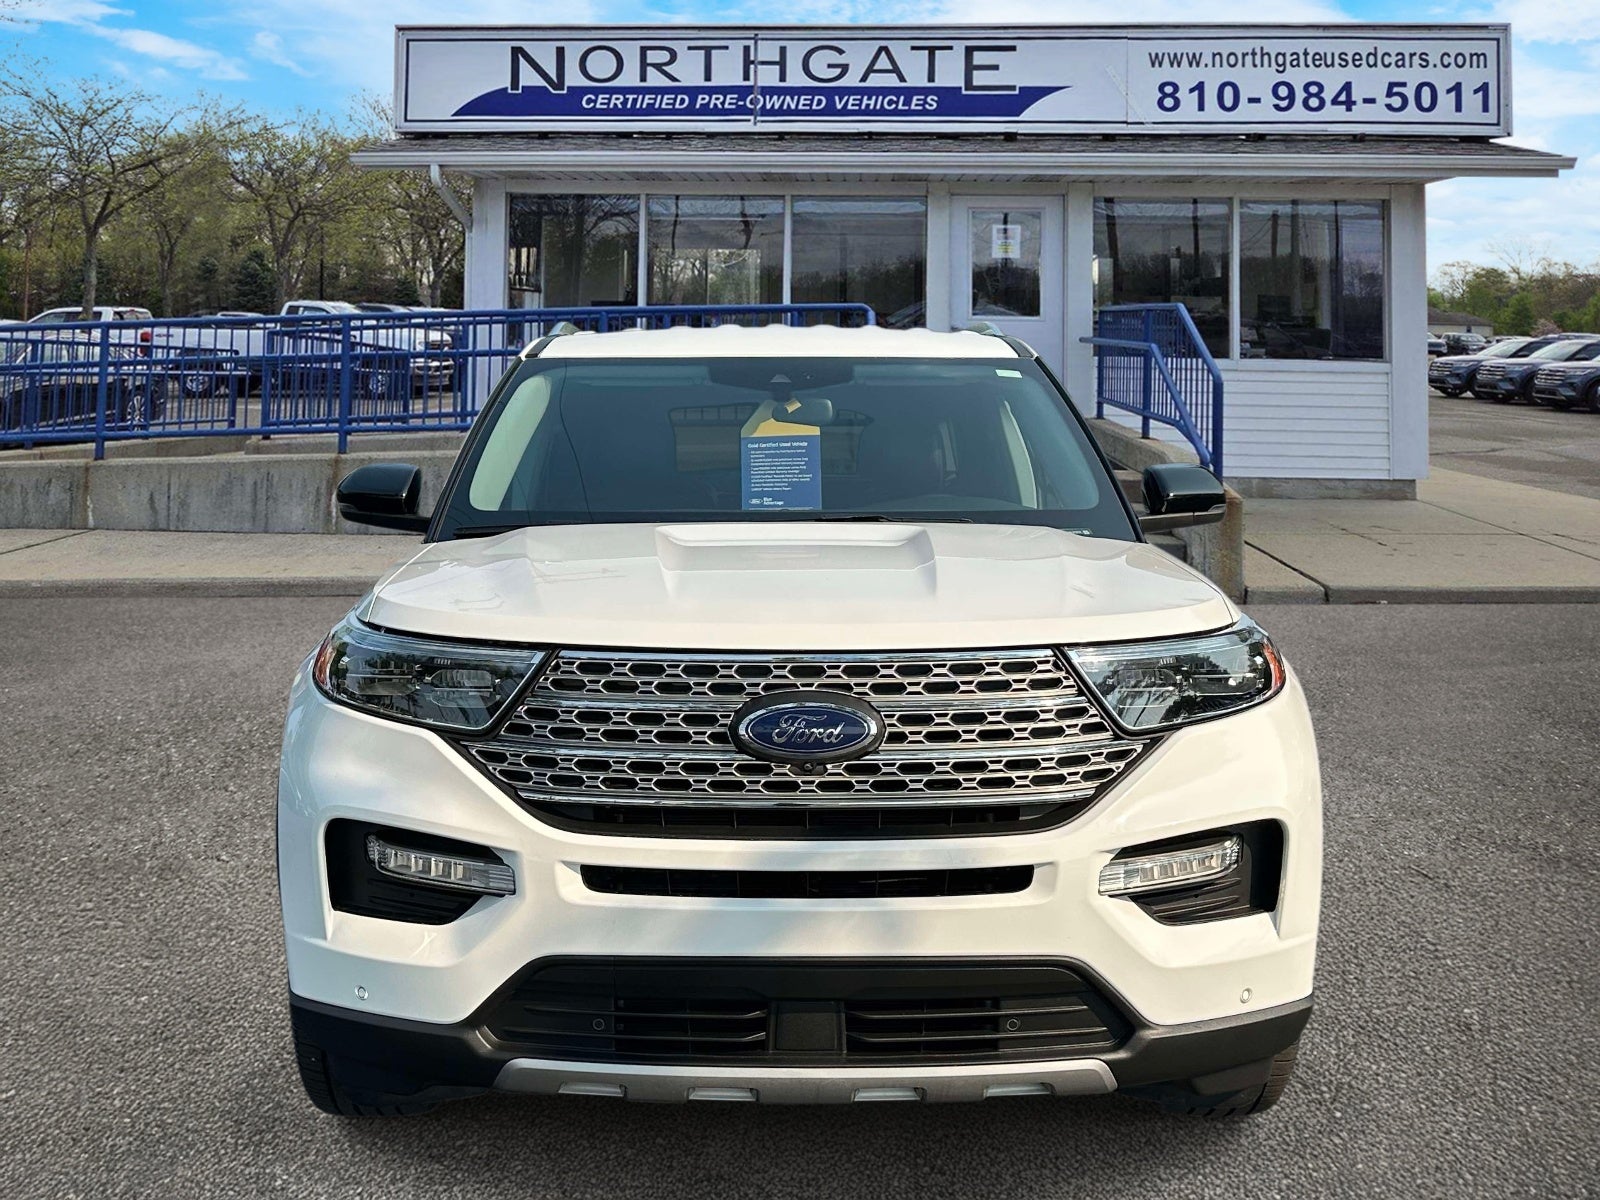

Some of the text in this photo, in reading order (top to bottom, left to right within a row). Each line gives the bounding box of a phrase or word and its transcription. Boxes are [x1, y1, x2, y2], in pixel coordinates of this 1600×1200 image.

[510, 45, 1017, 92] NORTHGATE
[1148, 46, 1488, 73] www.northgateusedcars.com
[581, 94, 939, 110] CERTIFIED PRE-OWNED VEHICLES
[1156, 80, 1492, 114] 810-984-5011
[772, 713, 846, 744] Ford
